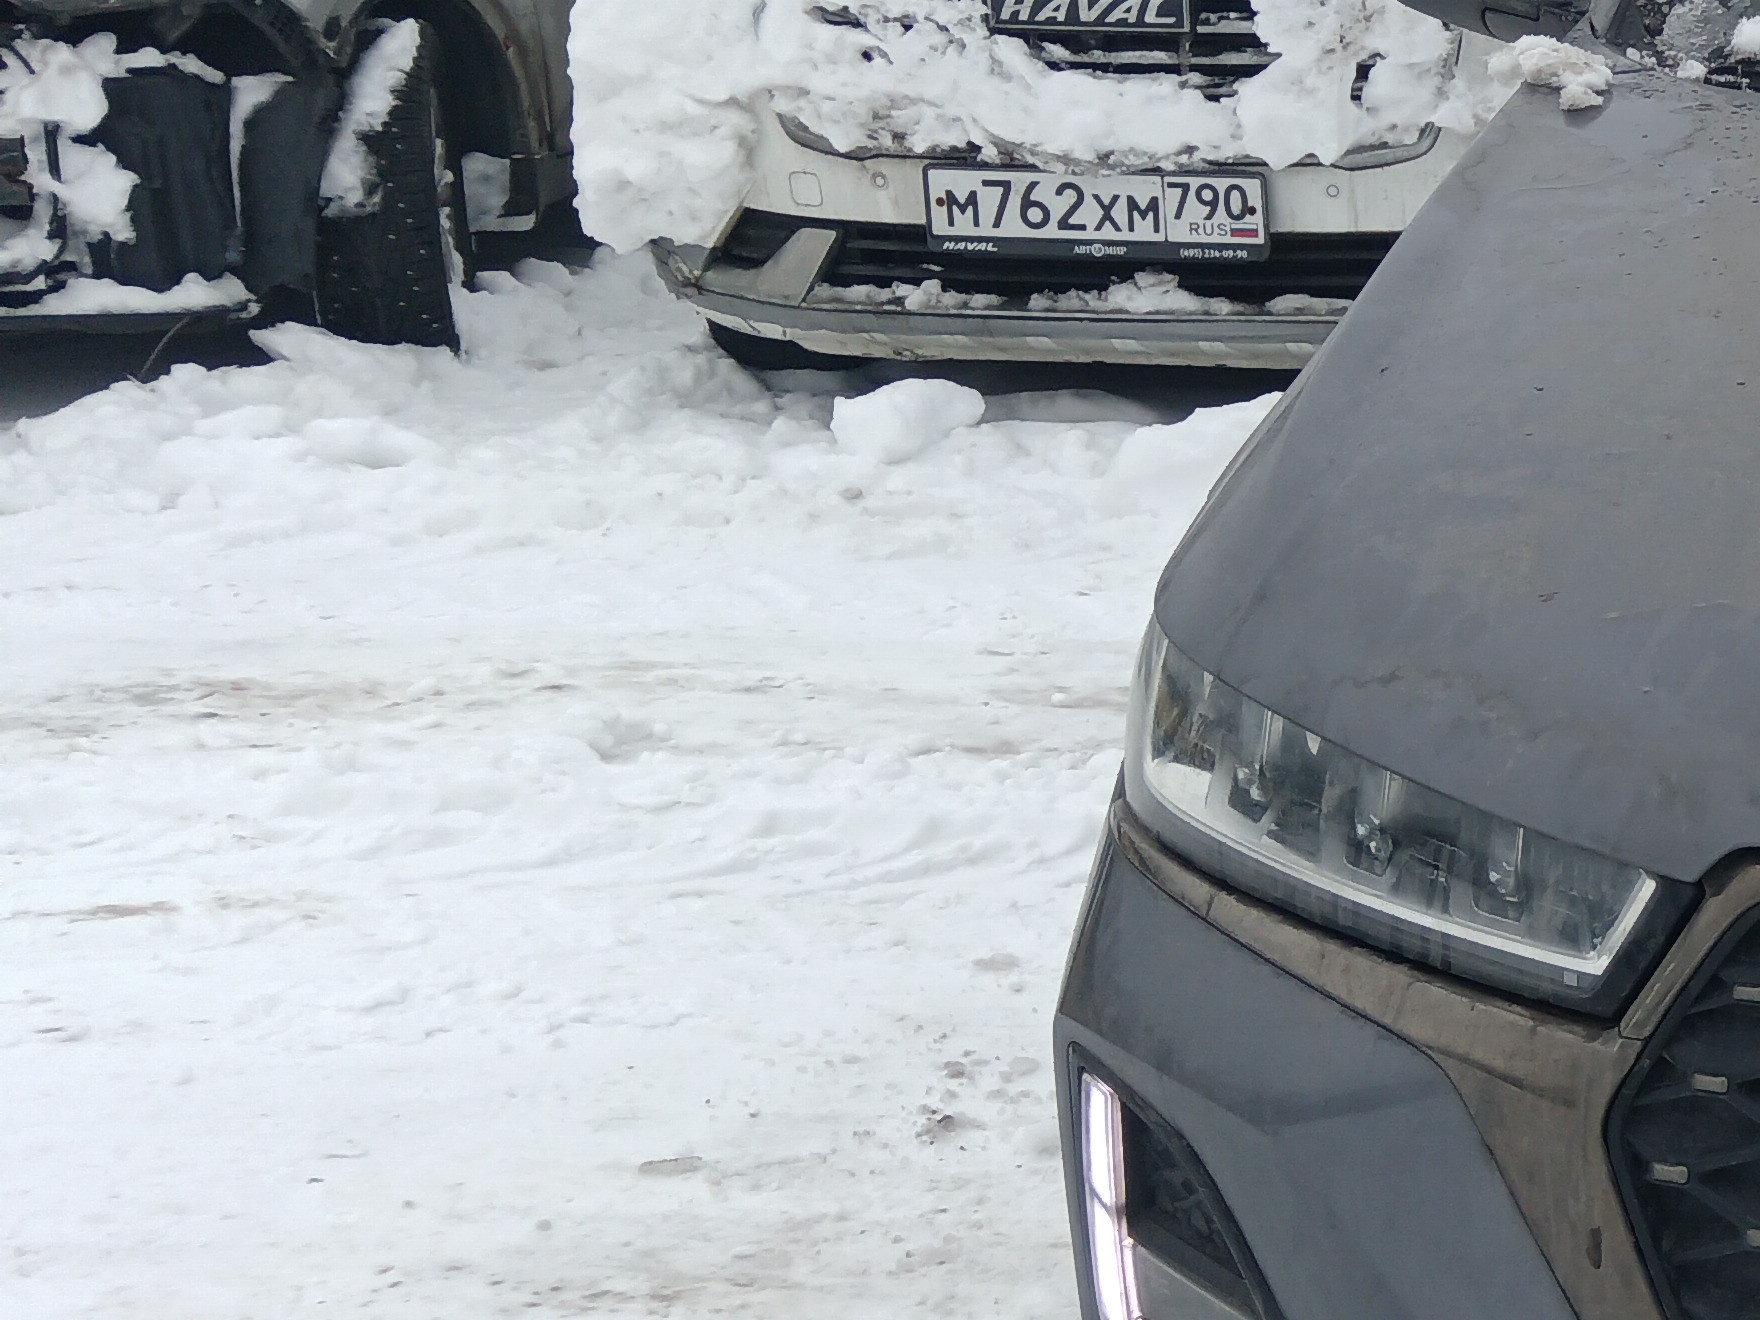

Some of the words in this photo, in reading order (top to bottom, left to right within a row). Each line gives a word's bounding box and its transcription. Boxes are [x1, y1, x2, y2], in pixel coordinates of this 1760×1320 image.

[945, 180, 1161, 233] М762ХМ
[1167, 182, 1249, 221] 790
[1189, 221, 1227, 237] RUS
[942, 241, 998, 252] HAVAL
